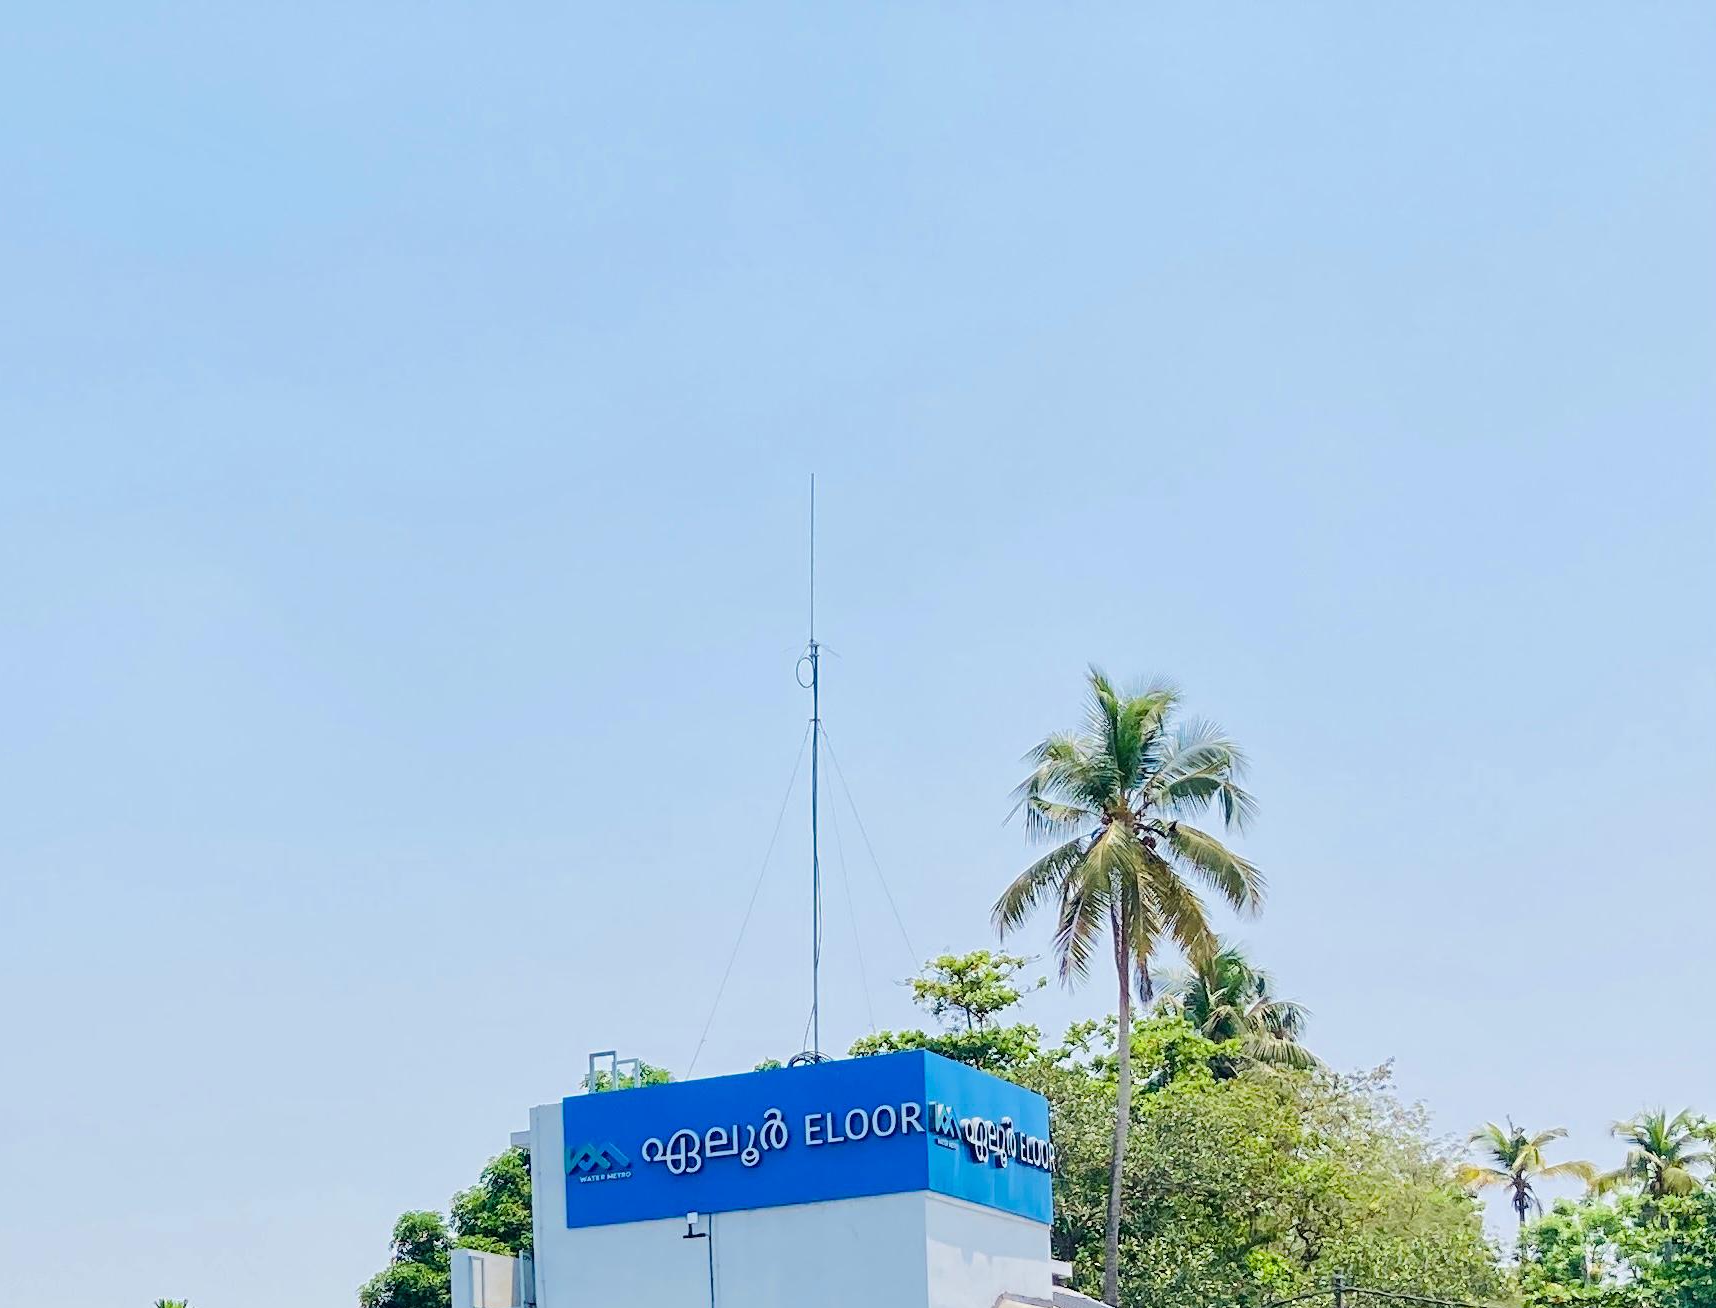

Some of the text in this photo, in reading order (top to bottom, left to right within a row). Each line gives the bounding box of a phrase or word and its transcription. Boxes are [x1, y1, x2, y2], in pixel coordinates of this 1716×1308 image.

[804, 1101, 925, 1146] ELOOR
[1020, 1131, 1057, 1174] ELOOR
[579, 1171, 632, 1183] WATER METRO
